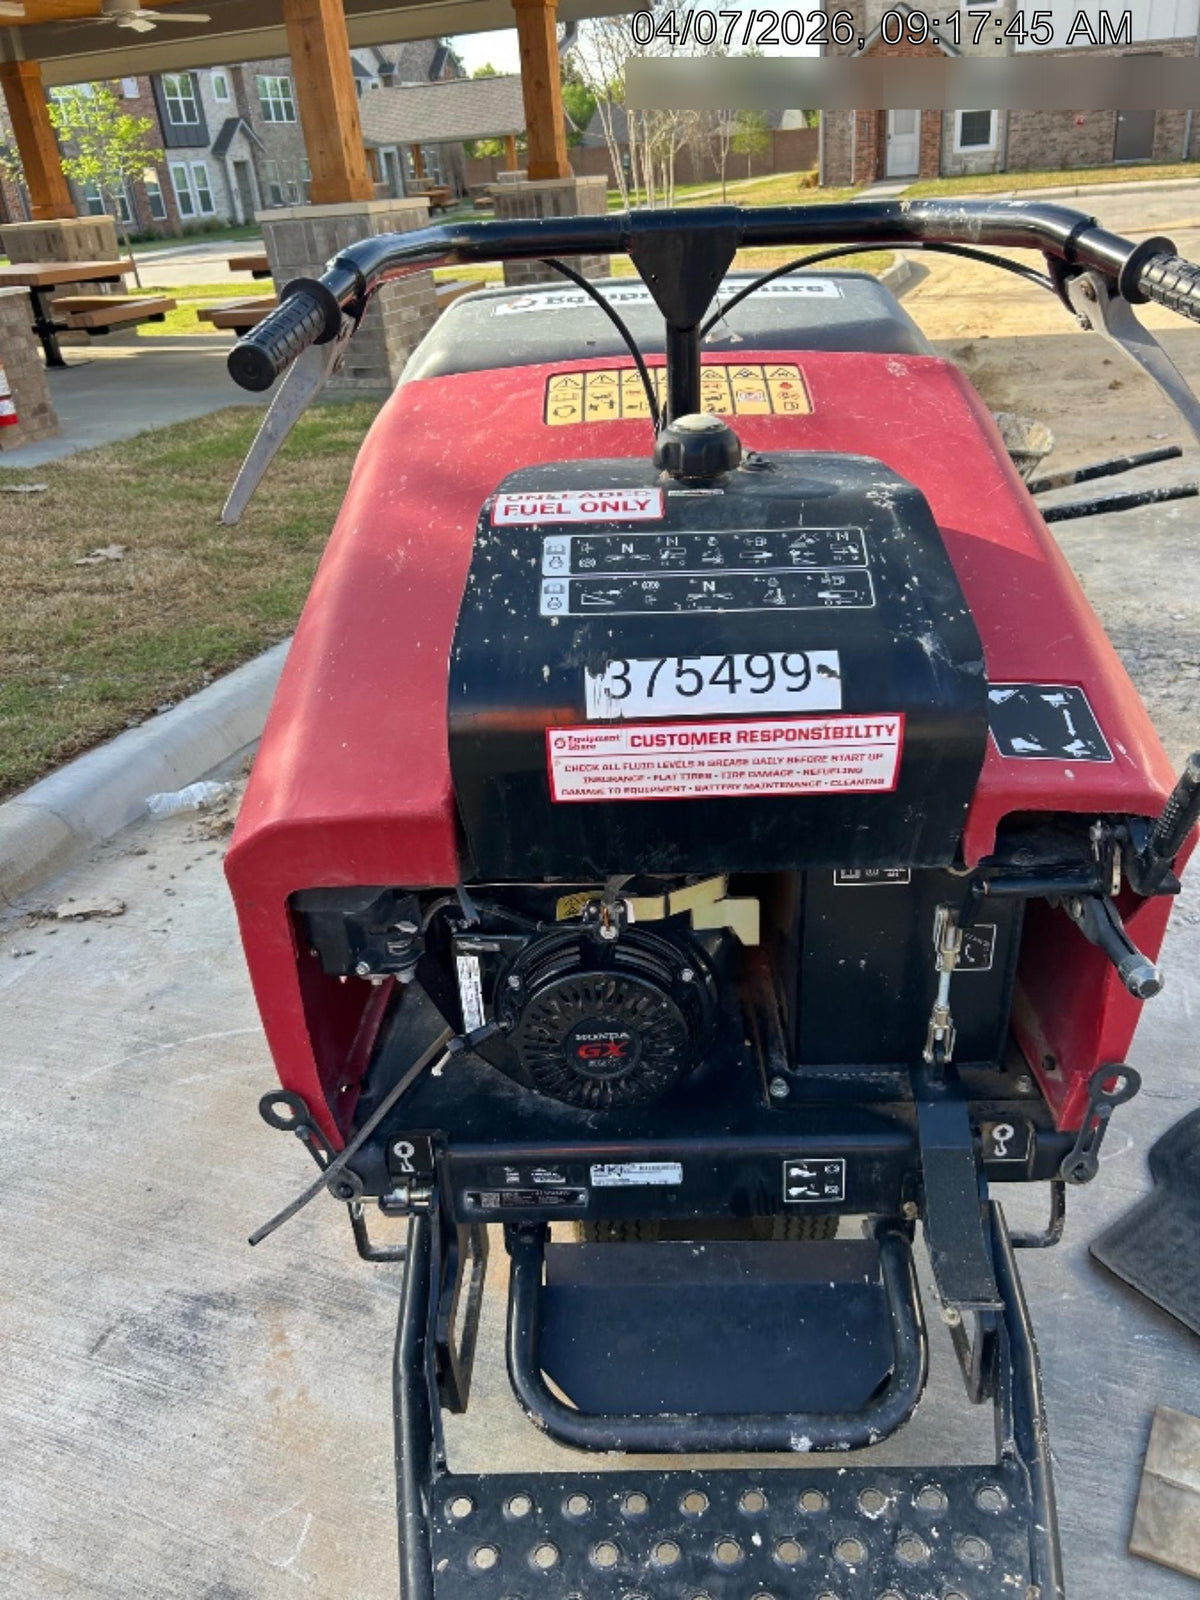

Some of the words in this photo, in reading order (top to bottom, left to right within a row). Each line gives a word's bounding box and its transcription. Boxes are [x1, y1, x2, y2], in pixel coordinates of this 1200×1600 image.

[506, 490, 651, 501] UNLEADED
[504, 502, 571, 516] FUEL
[580, 499, 651, 513] ONLY
[604, 653, 812, 699] 375499
[630, 732, 732, 747] CUSTOMER
[736, 724, 896, 744] RESPONSIBILITY
[565, 763, 600, 772] CHECK
[602, 763, 621, 771] ALL
[623, 762, 655, 770] FLUID
[657, 760, 698, 769] LEVELS
[752, 757, 784, 766] DAILY
[624, 785, 686, 793] EQUIPMENT
[575, 1032, 630, 1041] HONDA
[577, 1041, 627, 1059] GX
